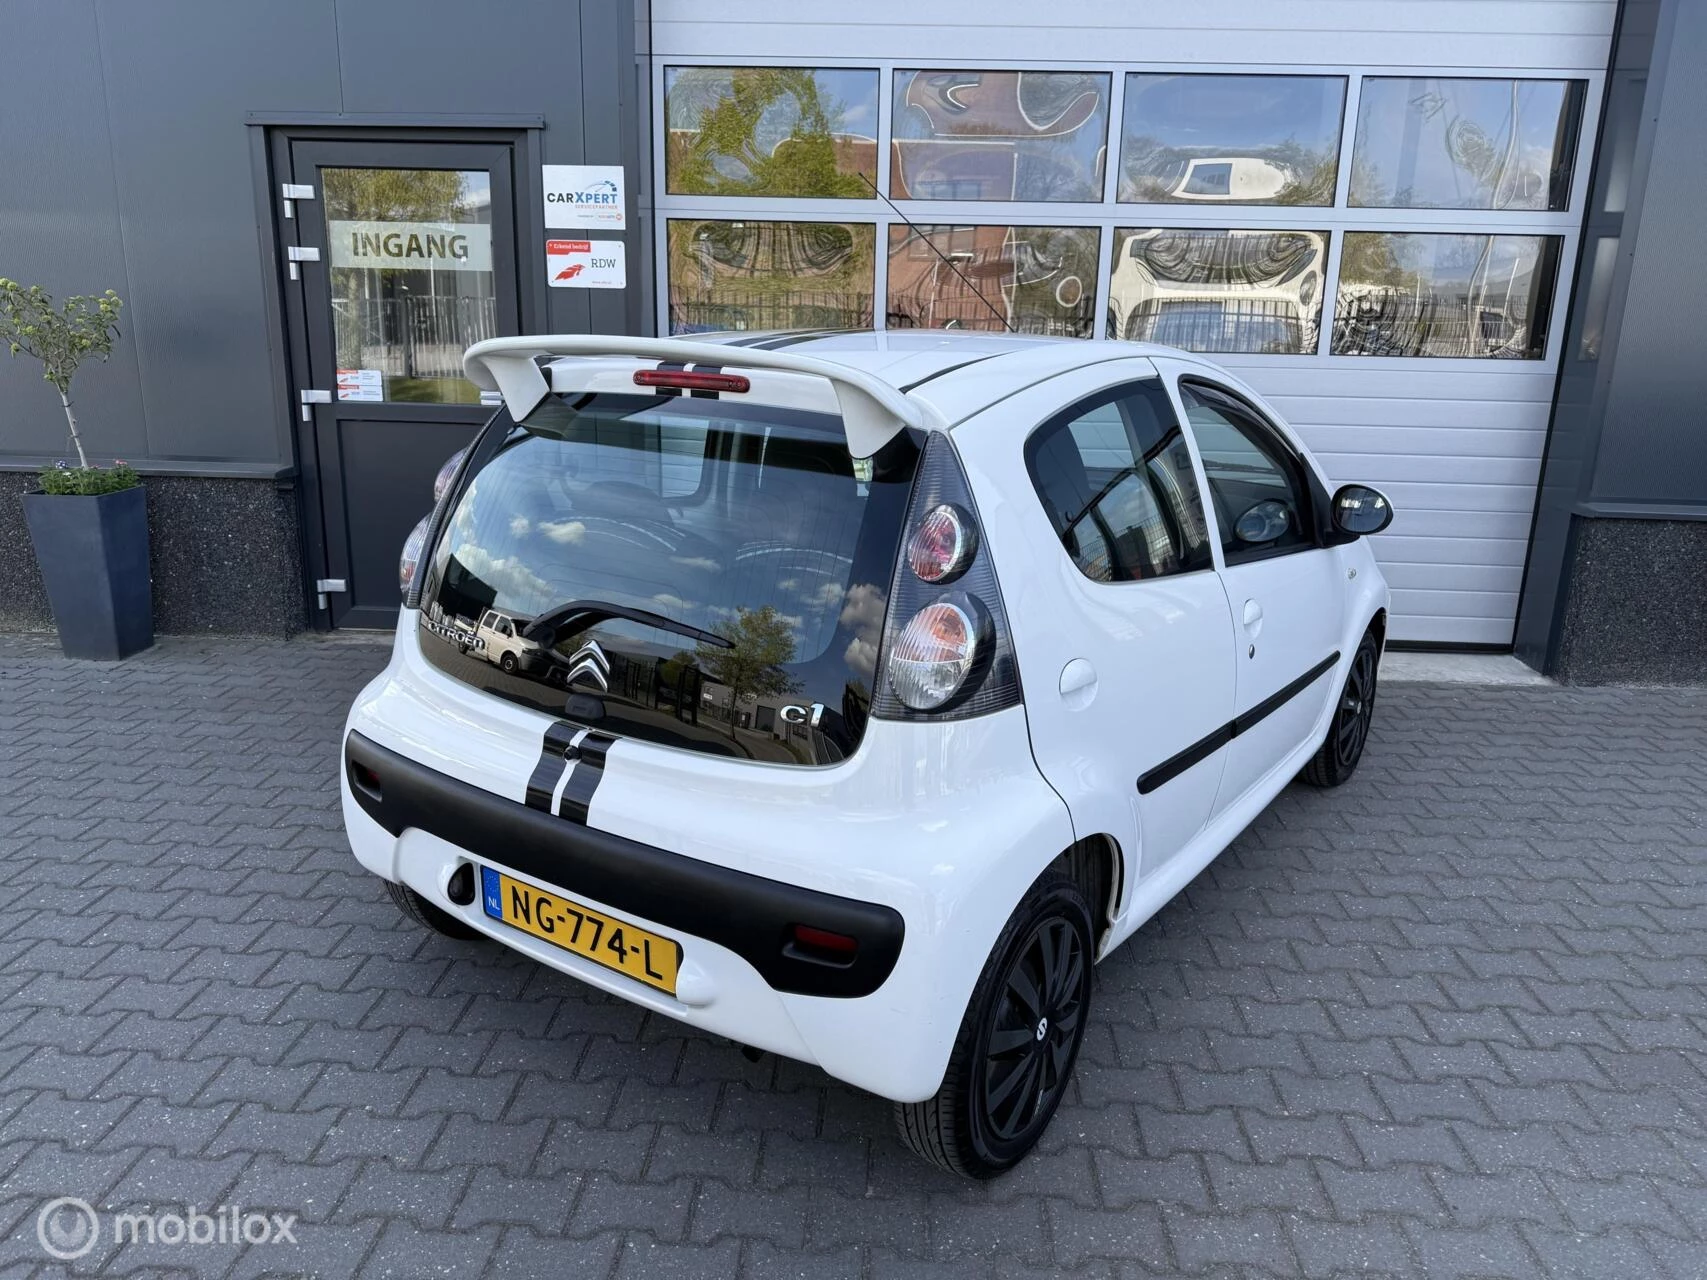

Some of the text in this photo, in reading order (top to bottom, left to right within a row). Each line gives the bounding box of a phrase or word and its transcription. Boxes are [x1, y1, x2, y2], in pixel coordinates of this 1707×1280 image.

[547, 191, 618, 204] CARXPERT
[351, 232, 469, 259] INGANG
[591, 258, 616, 268] RDW
[780, 703, 824, 728] C1
[488, 897, 500, 911] NL
[511, 885, 663, 980] NG-774-L
